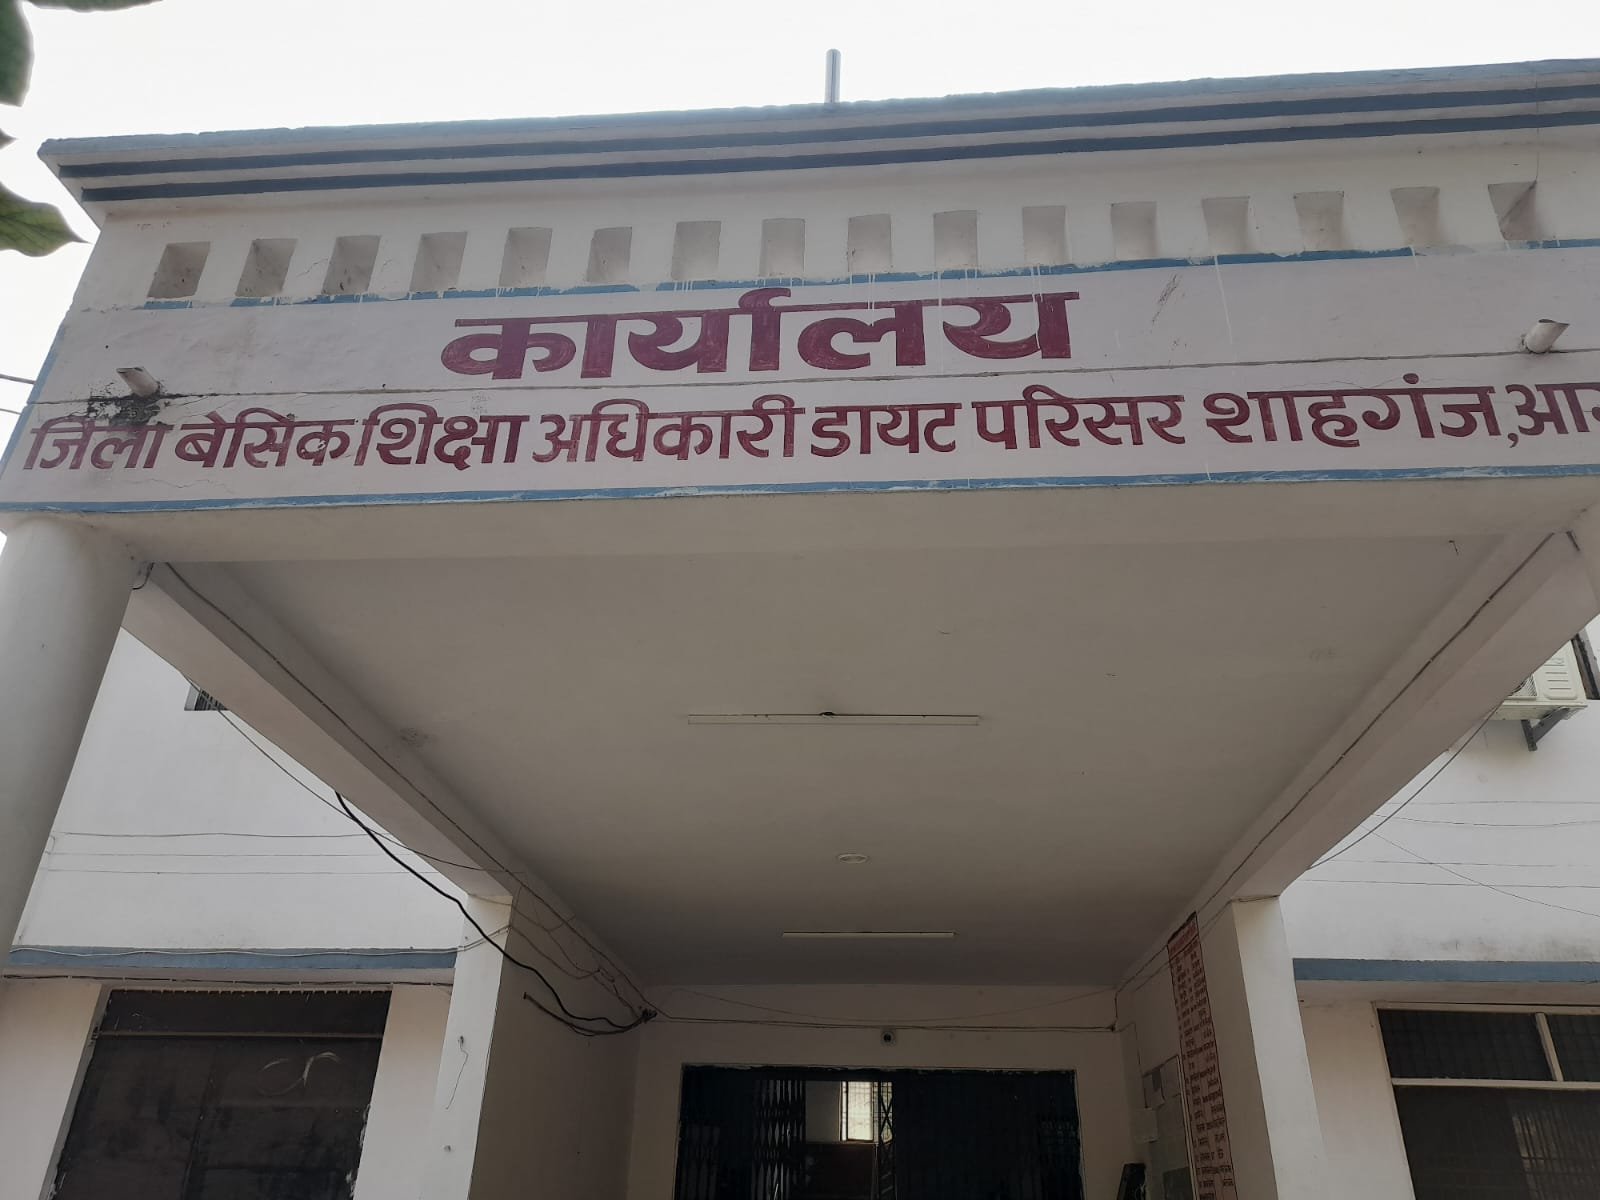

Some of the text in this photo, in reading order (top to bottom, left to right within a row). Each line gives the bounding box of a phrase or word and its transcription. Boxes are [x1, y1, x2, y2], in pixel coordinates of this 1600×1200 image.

[441, 287, 1080, 380] कार्यालय
[23, 416, 173, 470] जिला
[174, 407, 355, 469] बेसिक
[353, 403, 530, 471] शिक्षा
[532, 395, 805, 463] अधिकारी
[811, 402, 962, 457] डायट
[972, 385, 1185, 450] परिसर
